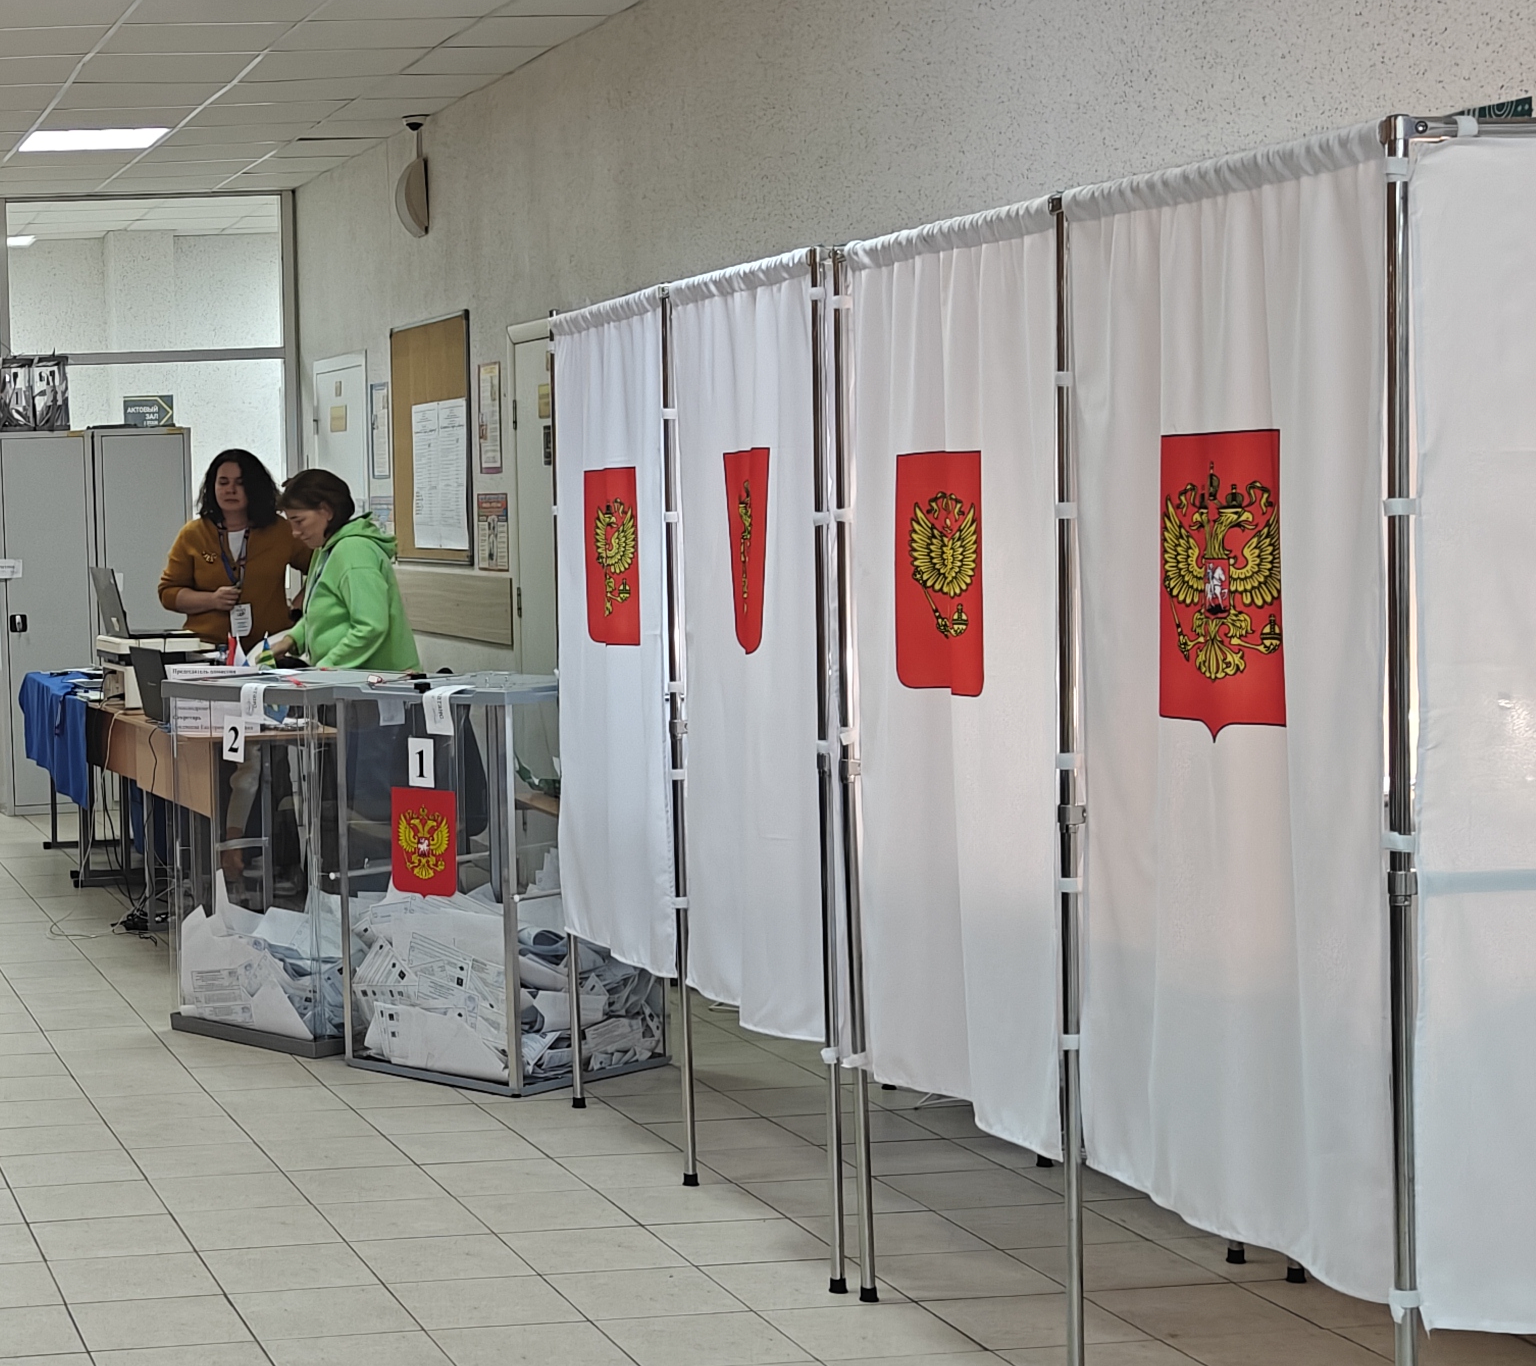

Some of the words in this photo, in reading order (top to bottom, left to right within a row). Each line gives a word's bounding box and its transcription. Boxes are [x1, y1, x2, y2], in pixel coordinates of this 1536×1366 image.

[126, 405, 159, 413] АКТОВЫЙ
[227, 726, 239, 753] 2
[415, 749, 427, 778] 1
